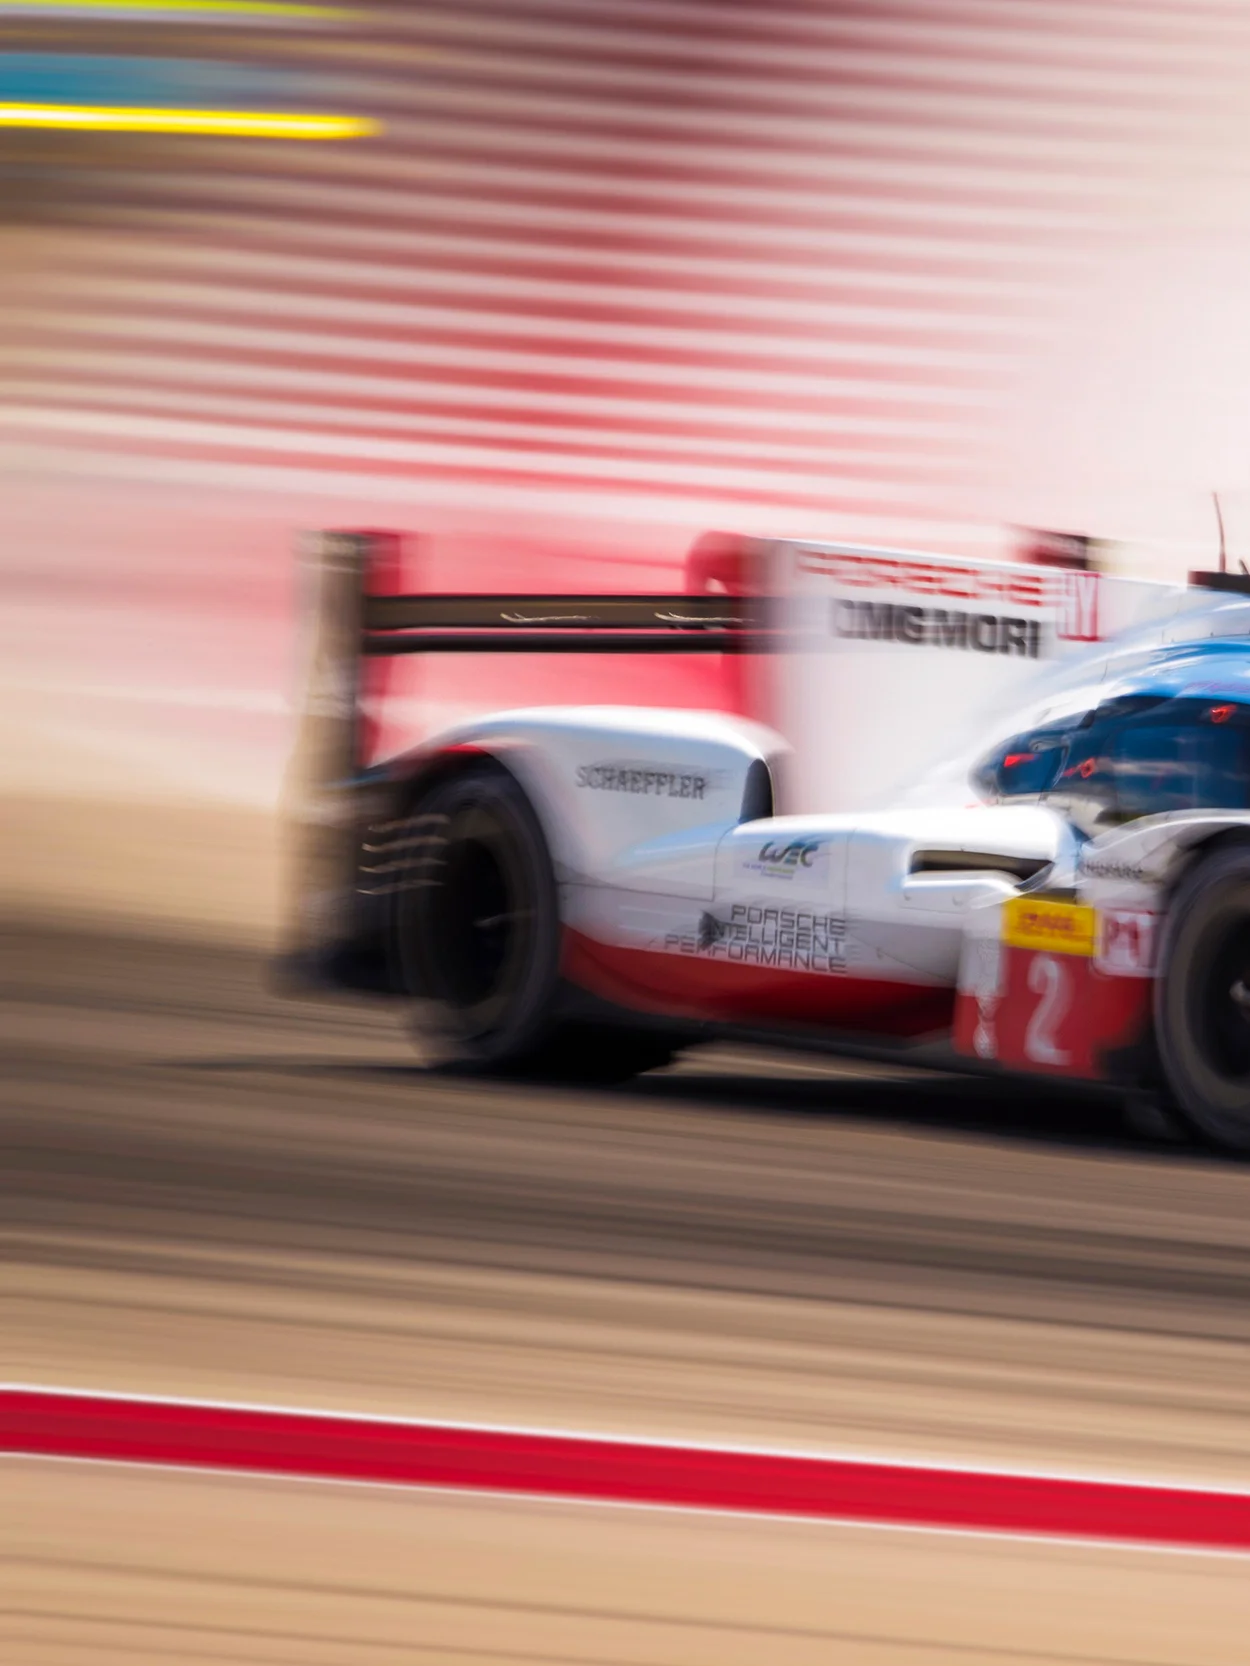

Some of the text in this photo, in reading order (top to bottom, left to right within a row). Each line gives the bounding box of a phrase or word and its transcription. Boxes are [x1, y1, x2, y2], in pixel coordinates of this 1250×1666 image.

[576, 764, 706, 801] SCHAEFFLER
[758, 840, 820, 868] WEC
[703, 918, 846, 956] NTELLIGENT
[730, 903, 847, 938] PORSCHE
[663, 933, 849, 975] PERFORMANCE
[1023, 955, 1072, 1066] 2
